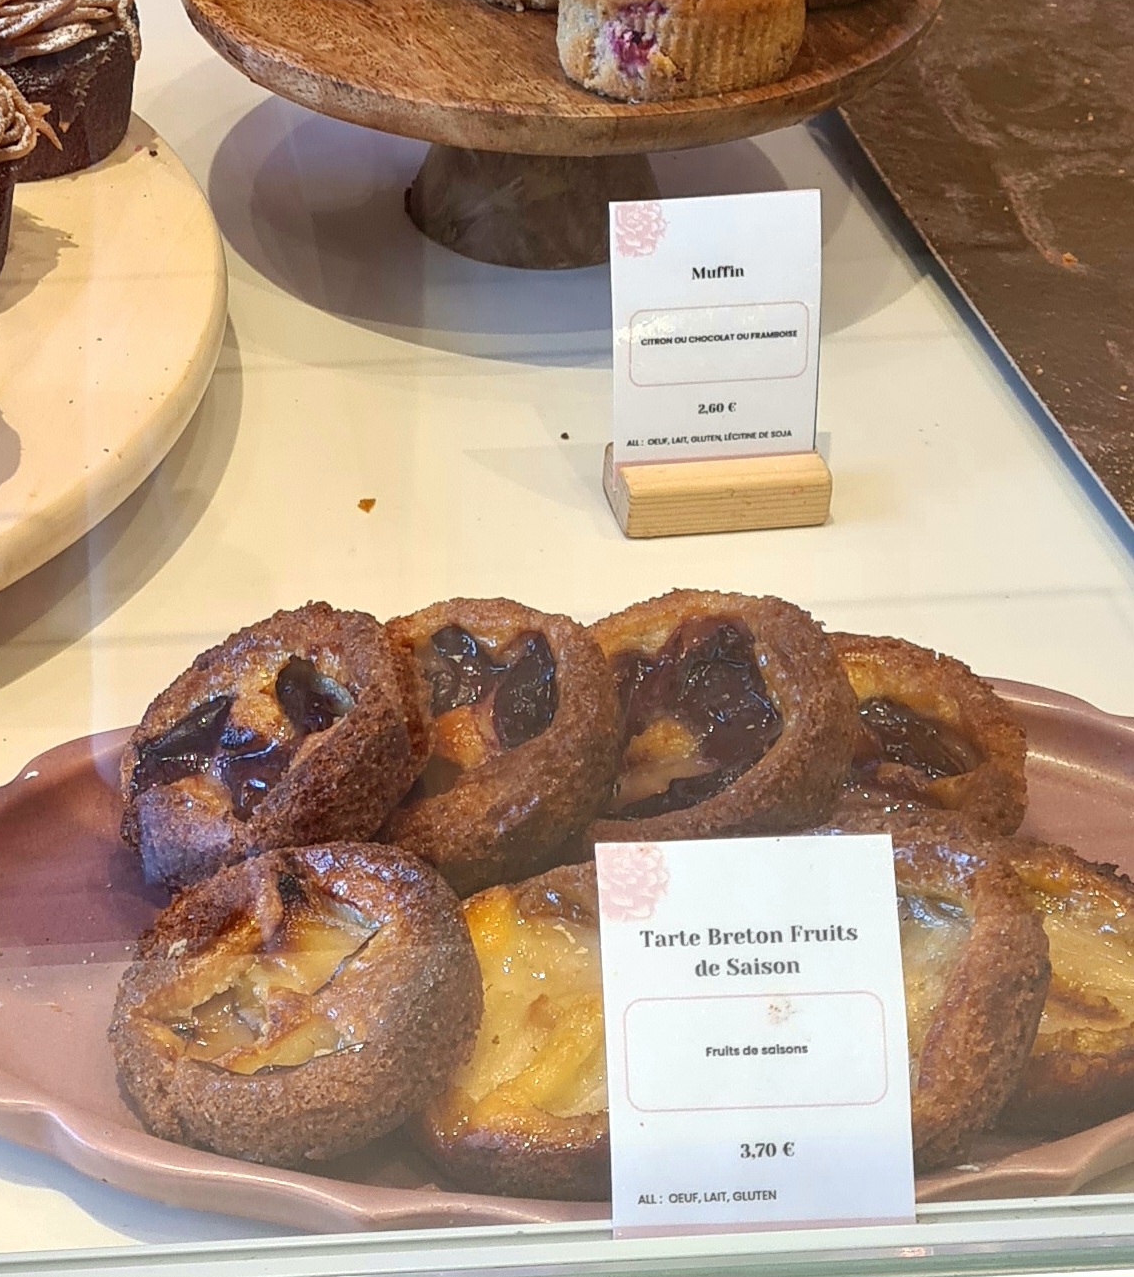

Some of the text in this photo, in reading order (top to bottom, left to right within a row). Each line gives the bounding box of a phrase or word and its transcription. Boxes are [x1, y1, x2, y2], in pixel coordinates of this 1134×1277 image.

[692, 265, 745, 280] Muffin
[640, 329, 798, 346] CITRON OU CHOCOLAT OU FRAMBOISE
[697, 402, 737, 415] 2,60 €
[626, 439, 640, 447] ALL
[758, 430, 769, 439] DE
[770, 429, 793, 439] SOJA
[639, 924, 859, 948] Tarte Breton Fruits
[694, 957, 800, 978] de Saison
[705, 1043, 809, 1058] Fruits de saisons
[740, 1141, 795, 1159] 3,70 €
[637, 1193, 658, 1205] ALL
[668, 1191, 702, 1204] OEUF,
[703, 1191, 731, 1203] LAIT,
[732, 1189, 777, 1202] GLUTEN
